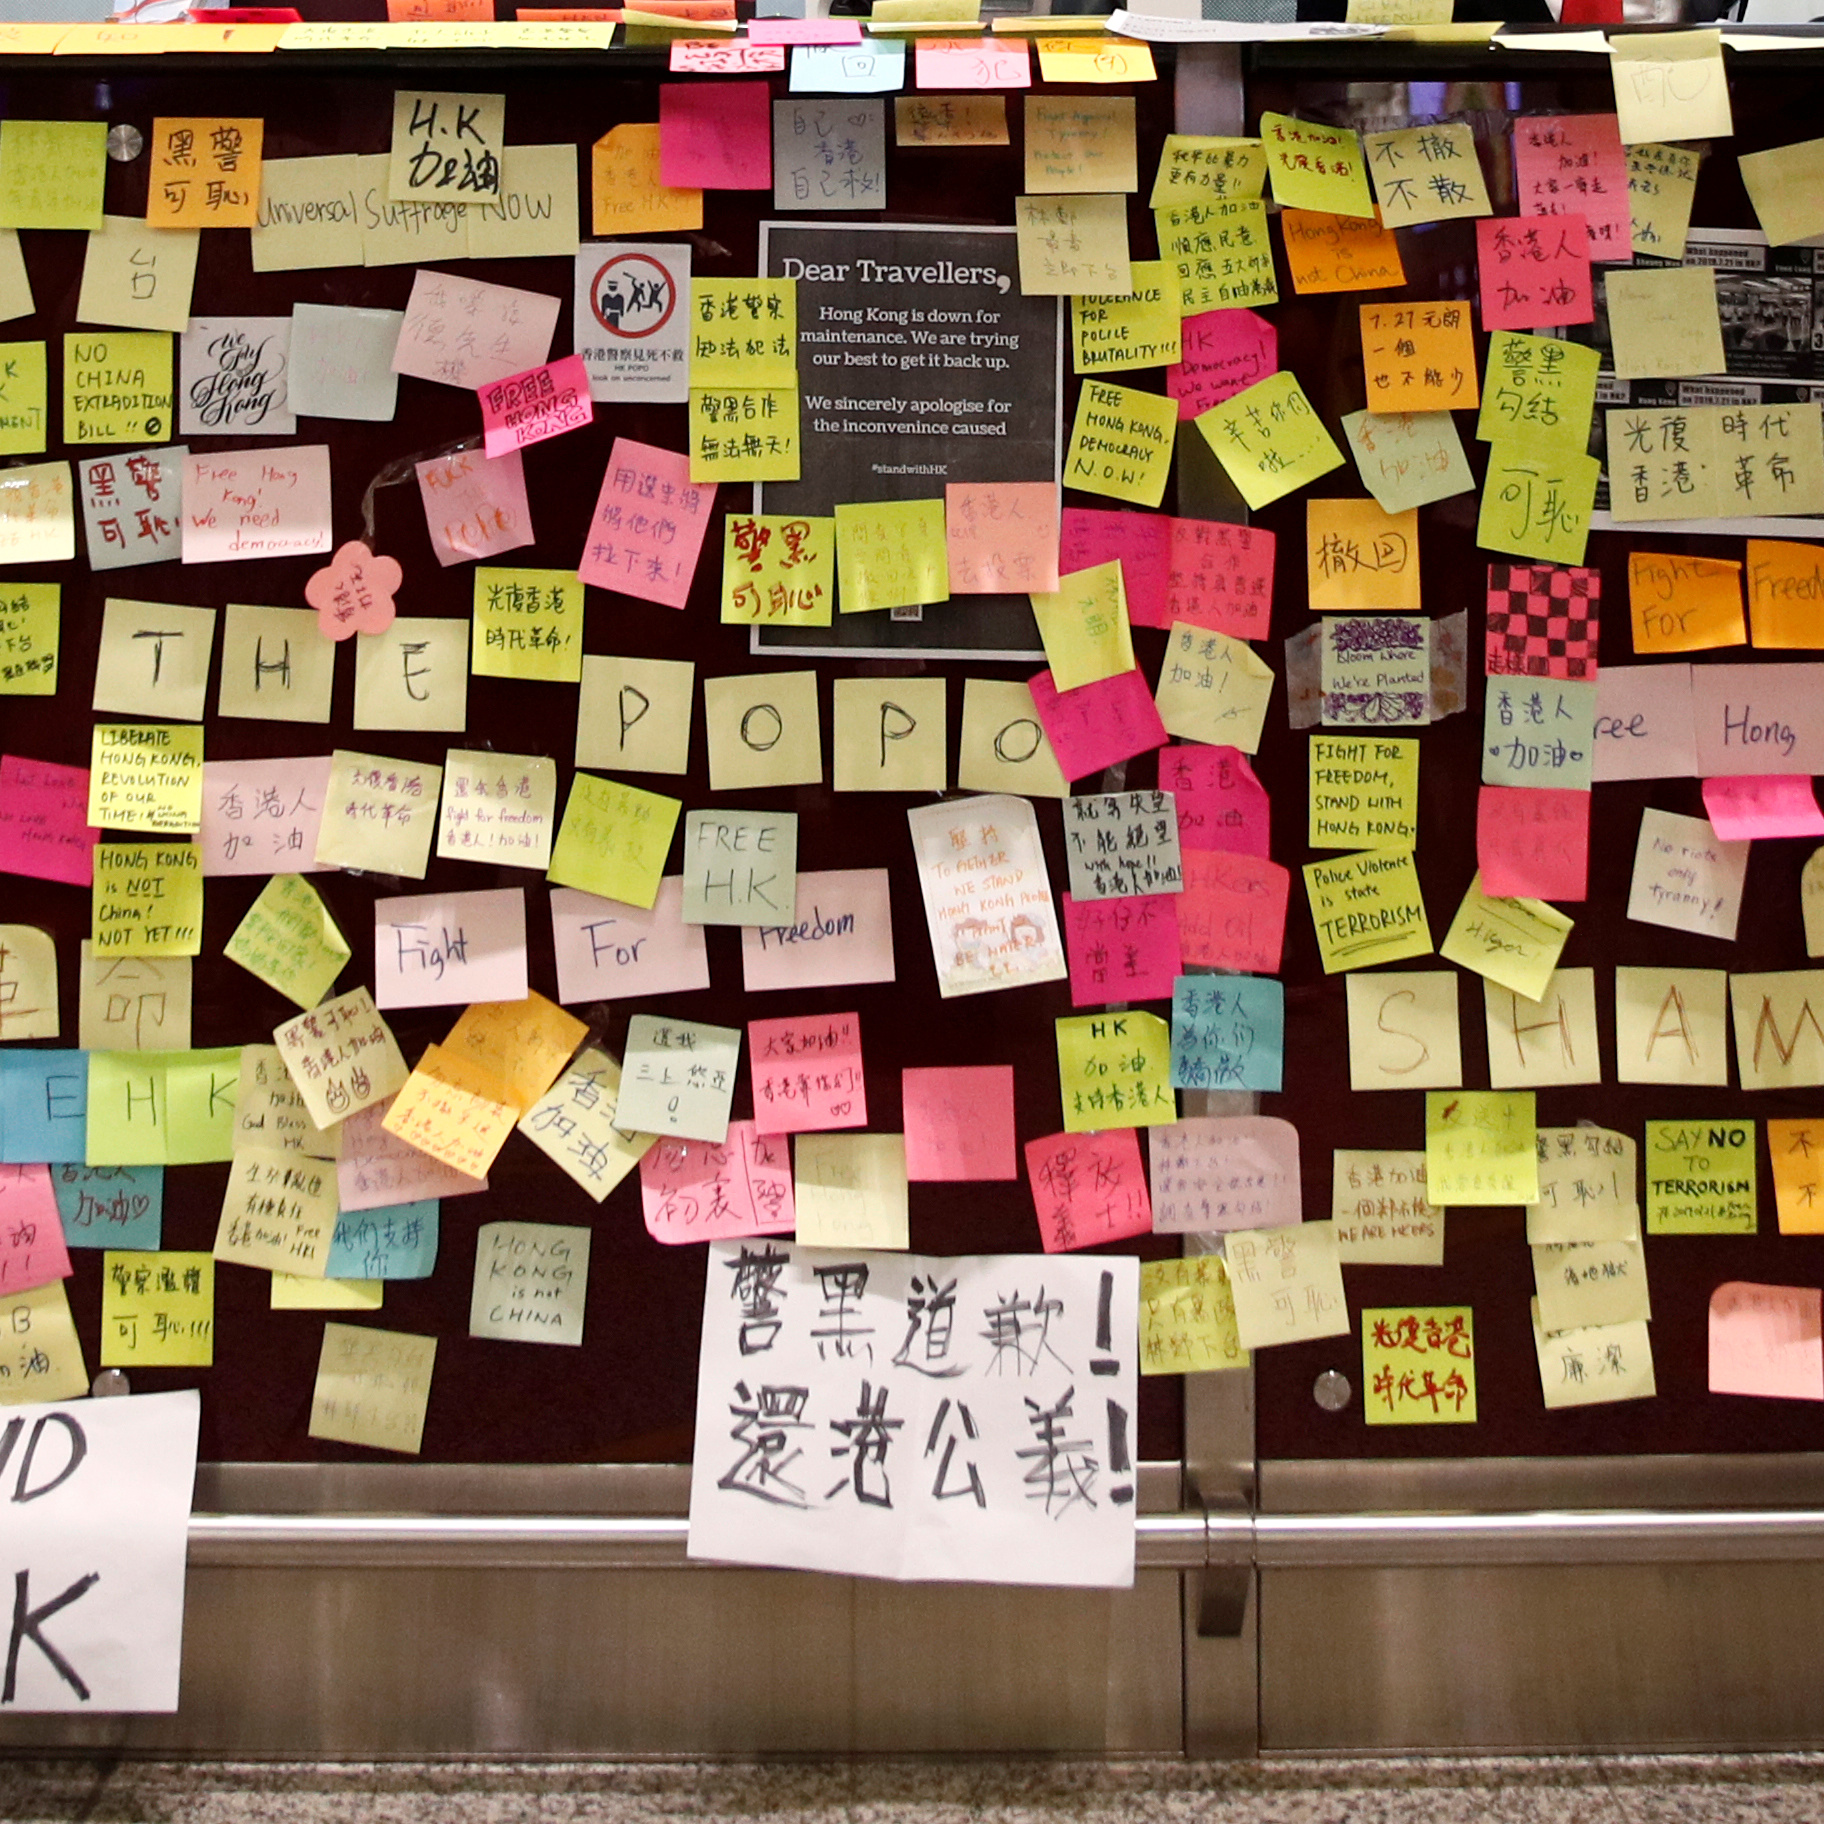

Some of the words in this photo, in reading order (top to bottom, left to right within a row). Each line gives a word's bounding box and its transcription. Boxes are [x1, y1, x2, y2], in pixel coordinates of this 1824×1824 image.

[257, 190, 358, 229] Universal
[782, 257, 850, 284] Dear
[853, 257, 1012, 295] Travellers,
[819, 305, 862, 329] Hong
[866, 305, 908, 329] Kong
[911, 306, 925, 323] is
[927, 306, 970, 323] down
[974, 306, 1001, 324] for
[1081, 309, 1108, 324] FOR
[800, 329, 907, 347] maintenance.
[911, 330, 936, 347] We
[939, 333, 966, 347] are
[970, 330, 1020, 351] trying
[75, 343, 107, 363] NO
[582, 348, 684, 363] 香港警察見死不救
[812, 354, 837, 367] our
[841, 351, 872, 368] best
[875, 352, 891, 368] to
[894, 353, 920, 373] get
[923, 352, 934, 368] it
[937, 351, 976, 369] back
[980, 354, 1010, 374] up.
[75, 369, 146, 388] CHINA
[628, 364, 649, 372] POPO
[487, 370, 556, 413] FREE
[1089, 385, 1123, 407] FREE
[74, 392, 173, 413] EXTRADITION
[505, 390, 579, 426] HONG
[804, 395, 832, 412] We
[834, 395, 906, 418] sincerely
[910, 396, 984, 419] apologise
[987, 397, 1012, 414] for
[77, 420, 116, 439] BILL
[514, 410, 588, 443] KONG
[813, 418, 838, 434] the
[842, 418, 941, 436] inconvenince
[943, 419, 1007, 436] caused
[1086, 412, 1125, 433] HONG
[194, 463, 237, 483] Free
[261, 465, 299, 488] Hong
[871, 463, 948, 475] #standwithHK
[239, 509, 281, 527] need
[487, 584, 565, 614] 光復香港
[1497, 691, 1573, 726] 香港人
[100, 729, 172, 747] LIBERATE
[1723, 705, 1797, 756] Hong
[100, 752, 146, 769] HONG
[1314, 743, 1367, 762] FIGHT
[1373, 743, 1403, 761] FOR
[100, 773, 190, 788] REVOLUTION
[101, 792, 119, 804] OF
[126, 792, 157, 804] OUR
[1315, 795, 1360, 811] STAND
[1366, 794, 1403, 810] WITH
[697, 823, 776, 853] FREE
[1317, 818, 1361, 837] HONG
[100, 850, 149, 870] HONG
[155, 850, 197, 868] KONG
[126, 878, 165, 897] NOT
[1321, 905, 1423, 946] TERRORISM
[97, 929, 137, 947] NOT
[582, 918, 647, 969] For
[390, 923, 468, 980] Fight
[1090, 1020, 1128, 1039] HK
[1654, 1127, 1707, 1153] SAY
[1708, 1127, 1746, 1149] NO
[1683, 1156, 1710, 1174] TO
[493, 1234, 572, 1262] HONG
[488, 1261, 574, 1283] KONG
[510, 1286, 527, 1299] is
[534, 1285, 562, 1299] not
[488, 1306, 563, 1326] CHINA
[722, 1244, 1121, 1377] 警黑道歉!
[1370, 1315, 1472, 1360] 光復香港
[1372, 1371, 1469, 1413] 時代革命
[717, 1379, 1135, 1521] 還港公義!
